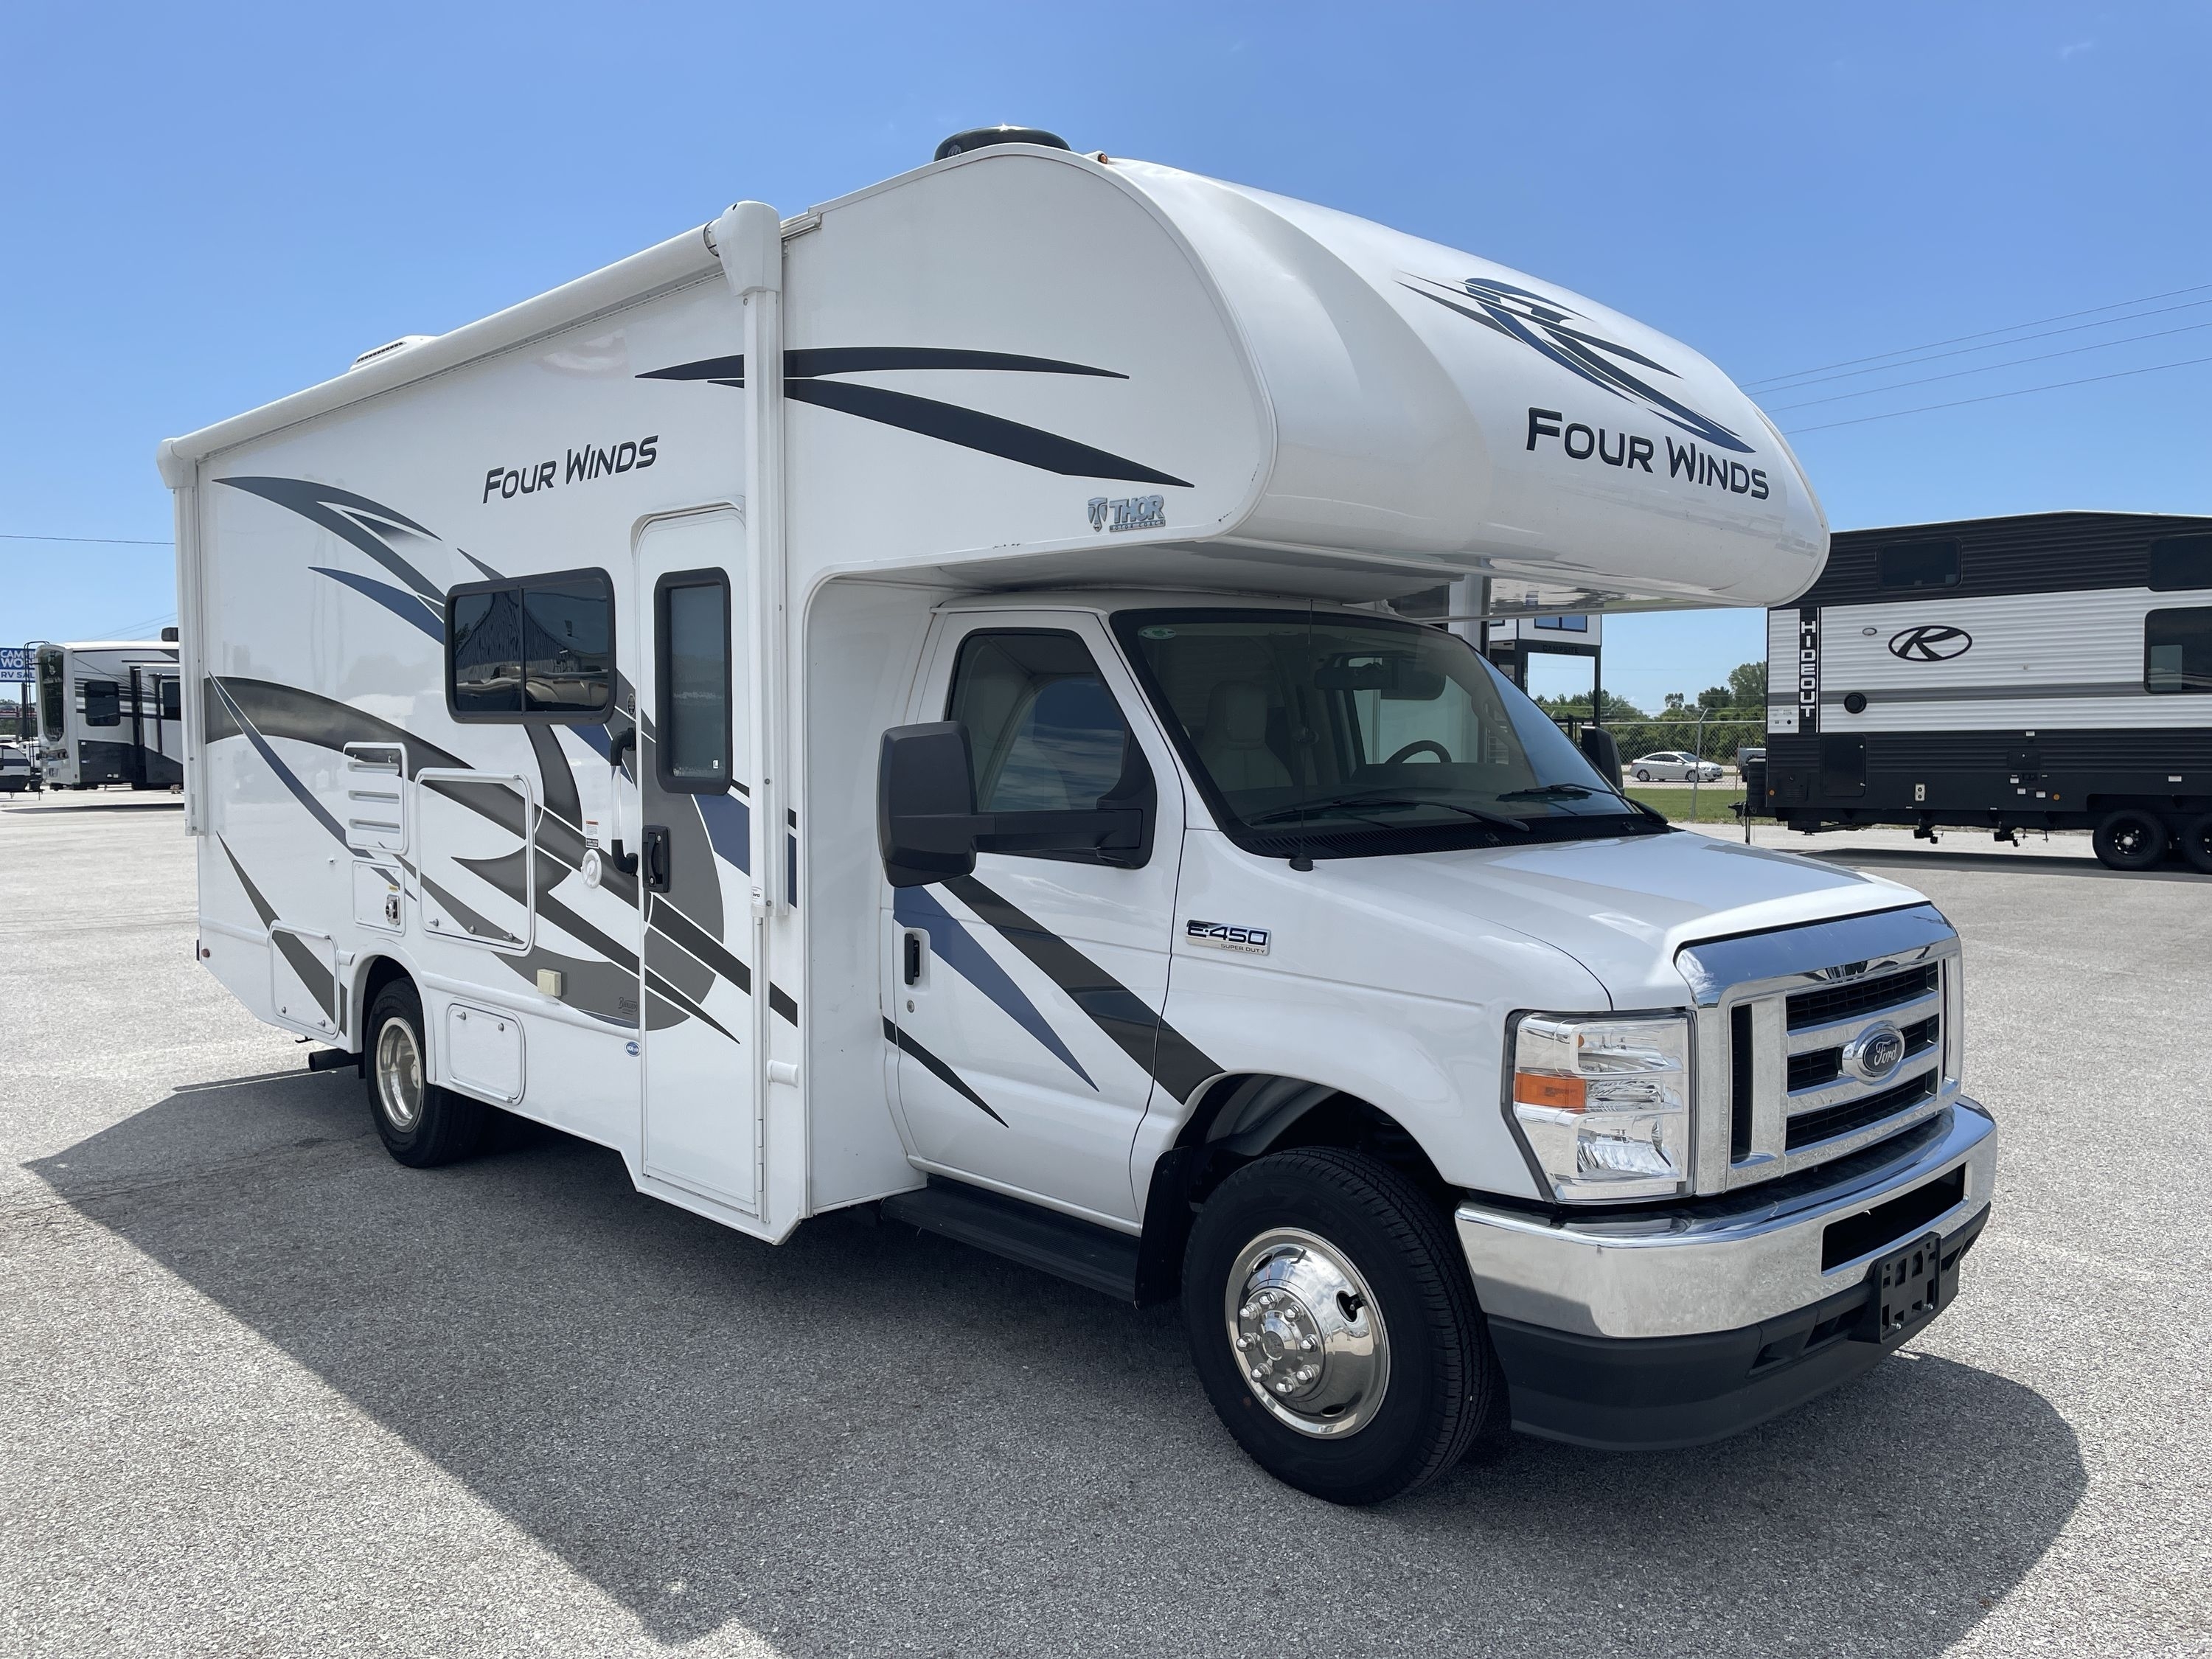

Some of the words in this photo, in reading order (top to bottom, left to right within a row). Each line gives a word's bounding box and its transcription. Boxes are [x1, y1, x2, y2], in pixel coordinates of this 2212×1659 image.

[483, 460, 556, 504] FOUR
[566, 435, 658, 484] WINDS
[1526, 406, 1654, 473] FOUR
[1665, 435, 1770, 501] WINDS
[1109, 495, 1165, 524] THOR
[1800, 620, 1816, 717] HIDEOUT
[1220, 943, 1244, 951] SUPER
[1874, 1040, 1898, 1067] Ford
